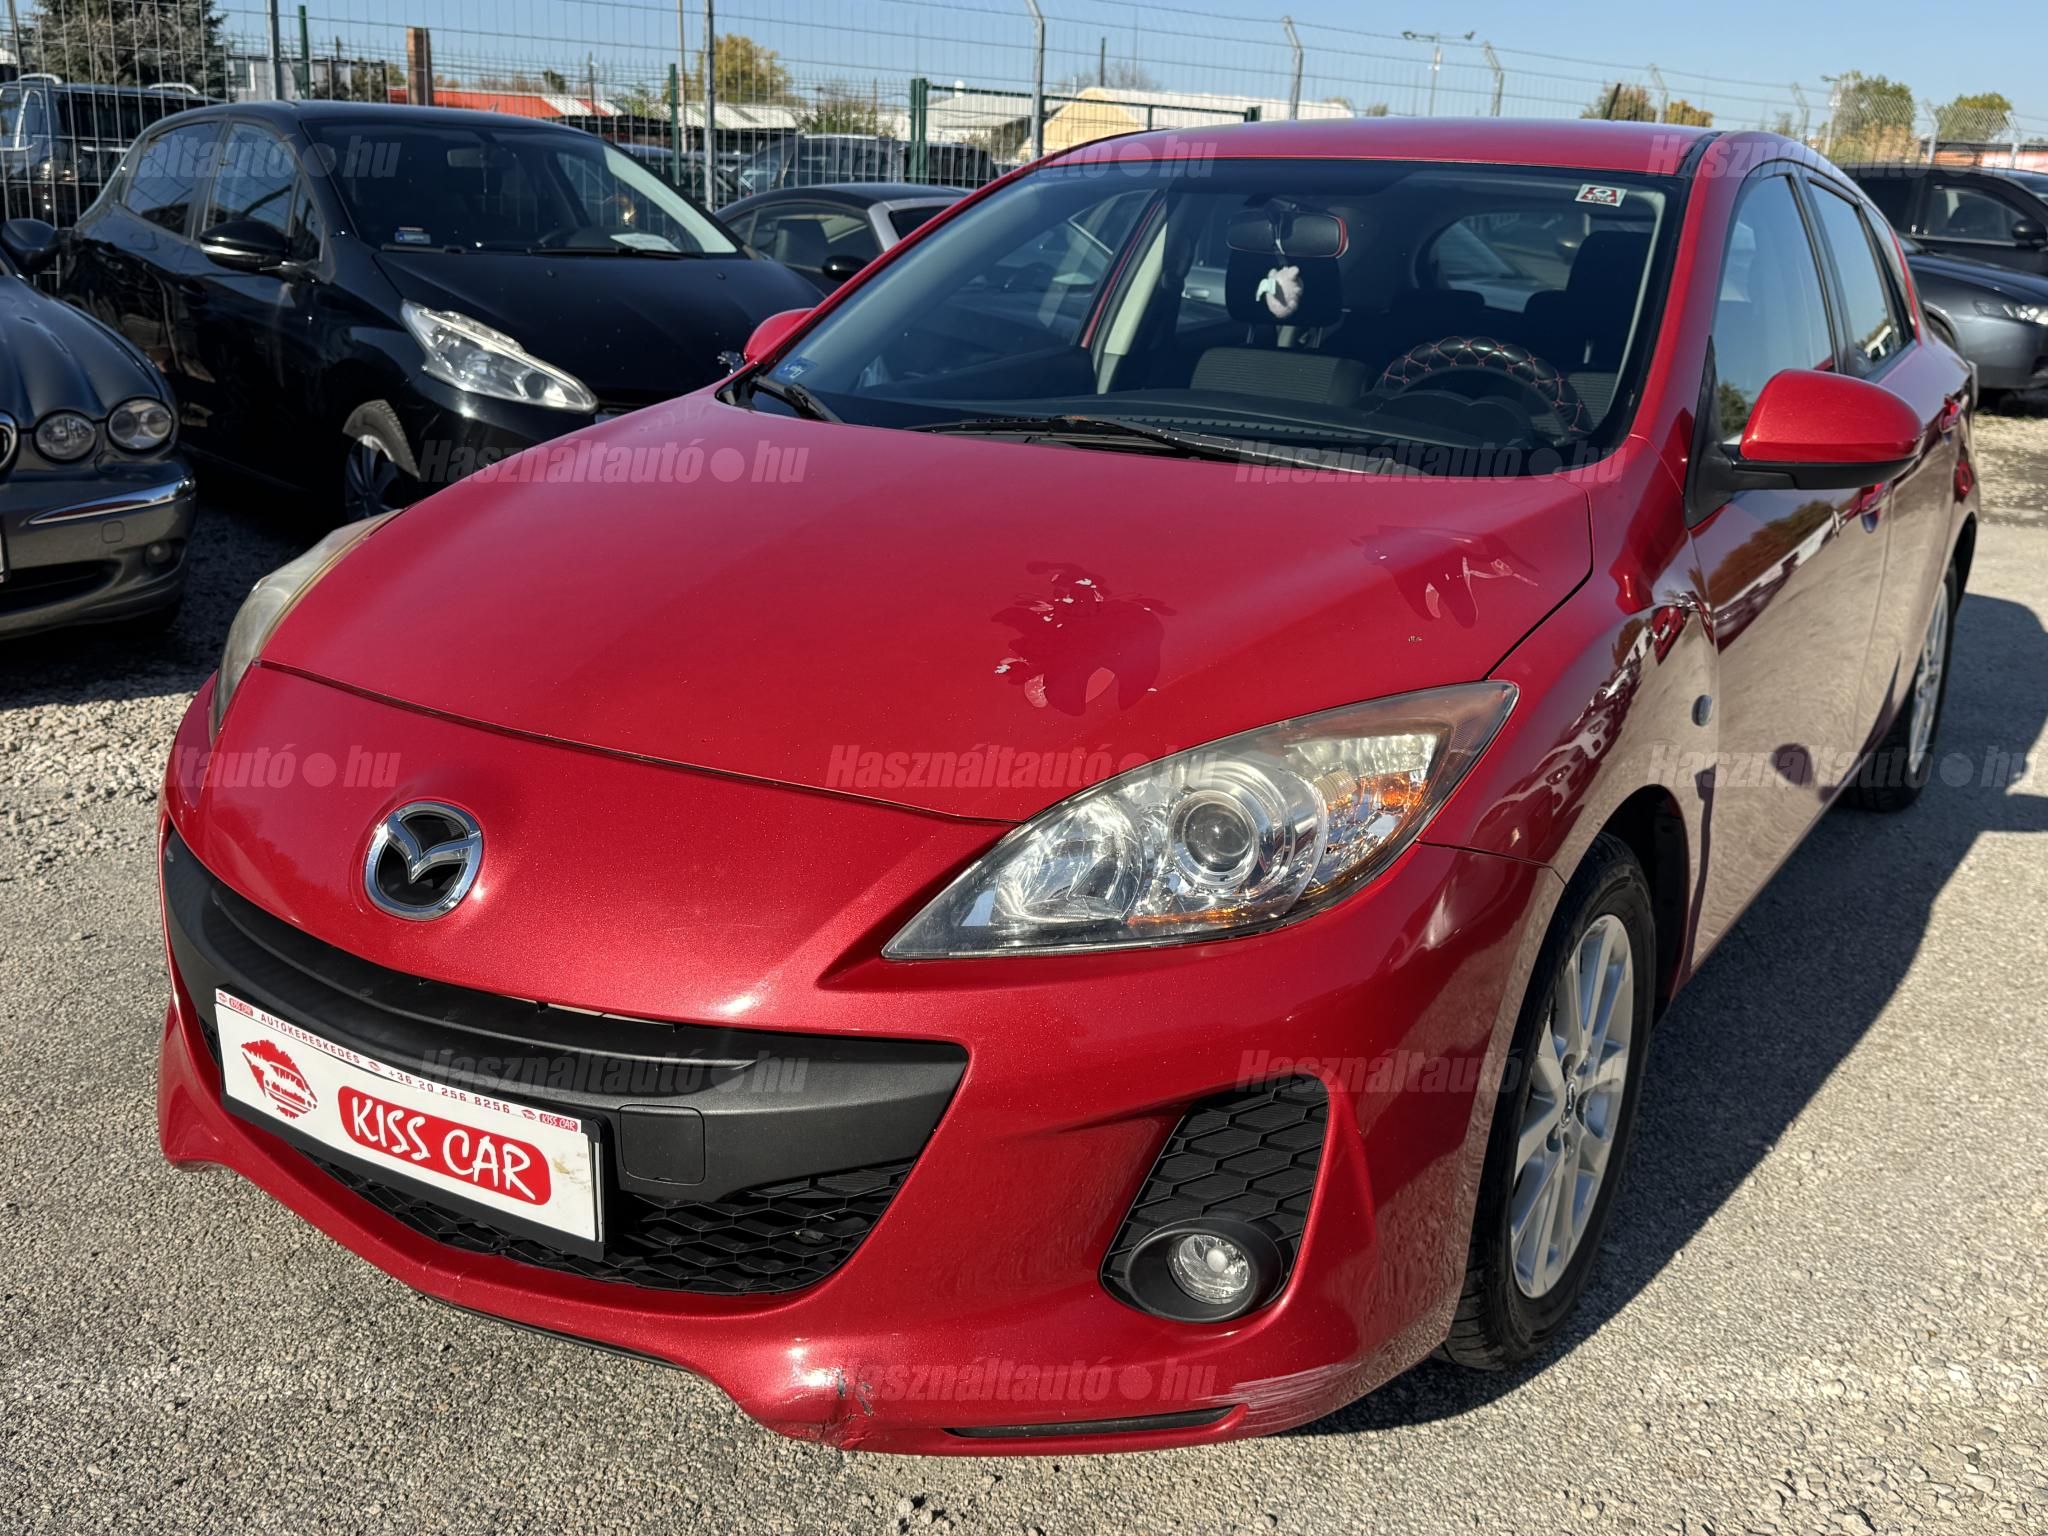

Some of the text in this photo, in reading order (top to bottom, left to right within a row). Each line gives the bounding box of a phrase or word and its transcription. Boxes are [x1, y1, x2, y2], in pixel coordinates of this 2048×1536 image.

[261, 1013, 360, 1064] AUTOKERESKEDÉS
[390, 1071, 412, 1085] +36
[419, 1080, 434, 1093] 20
[441, 1087, 467, 1102] 256
[474, 1096, 510, 1114] 8256
[541, 1114, 558, 1127] KISS
[560, 1118, 577, 1131] CAR
[352, 1096, 536, 1200] KISS CAR
